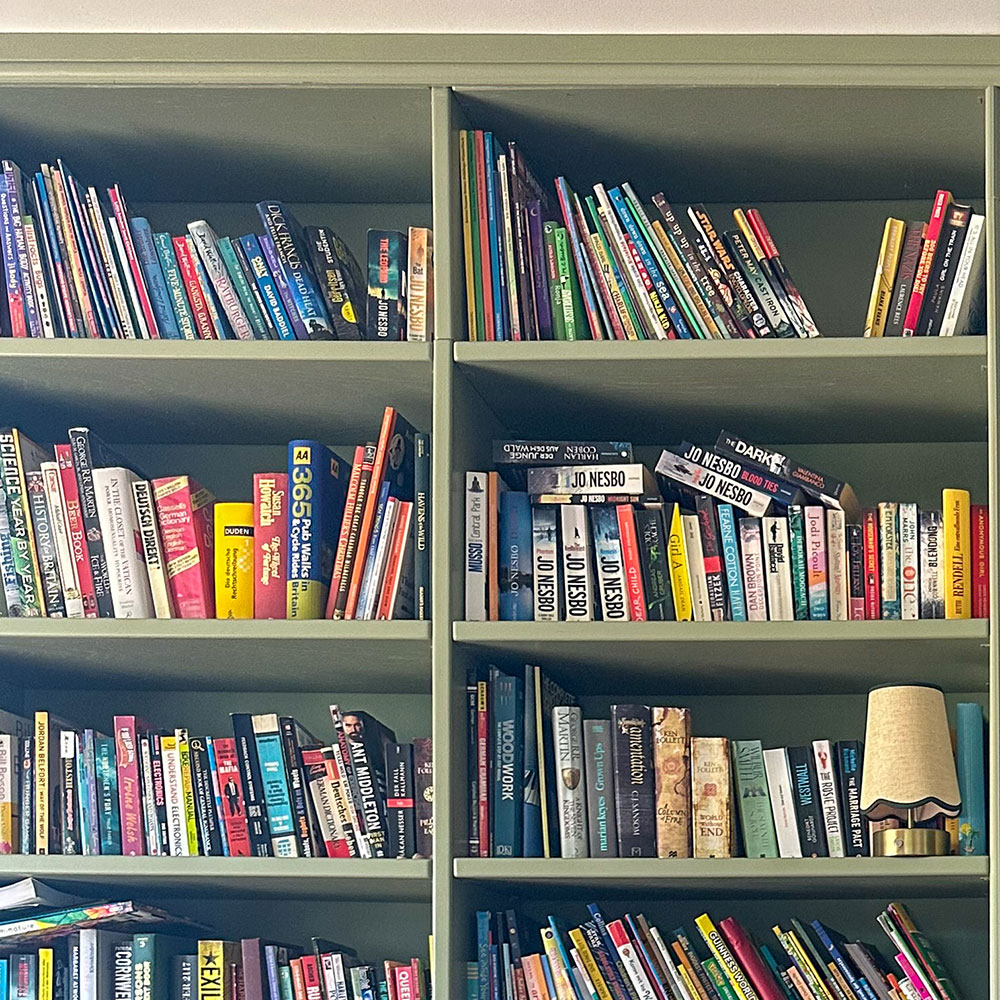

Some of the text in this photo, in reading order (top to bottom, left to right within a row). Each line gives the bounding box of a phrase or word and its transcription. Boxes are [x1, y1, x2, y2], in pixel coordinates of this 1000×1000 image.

[267, 204, 300, 270] DICK FRANCIS
[665, 209, 716, 298] up up up tree
[695, 210, 734, 271] STAR WARS
[15, 228, 32, 295] HUMAN BODY ACTIVITY
[731, 233, 780, 318] PETER MAY CAST IRON
[216, 277, 250, 340] RATBURGER
[264, 285, 289, 338] DAVID BADDIEL
[293, 271, 315, 318] DEAD HEAT
[410, 296, 425, 331] NESBO
[652, 279, 671, 302] sea
[732, 271, 759, 313] CHARACTER
[377, 312, 387, 337] NESBO
[659, 314, 670, 330] KID
[76, 437, 97, 518] GEORGE MARTIN
[295, 450, 308, 460] AA
[684, 446, 742, 479] JO NESBO
[259, 480, 275, 527] Howatch
[272, 491, 284, 516] Susan
[292, 469, 312, 517] 365
[572, 471, 625, 488] JO NESBO
[698, 473, 753, 506] JO NESBO
[741, 471, 779, 493] BLOOD TIES
[1, 434, 35, 604] SCIENCE YEAR BY YEAR
[67, 500, 84, 562] BEER BOOK
[110, 479, 133, 595] IN THE CLOSET VATICAN
[135, 483, 160, 566] DEUTSCH DIREKT
[333, 464, 362, 579] MALCOLM CHRISTMAS
[471, 497, 481, 538] Central Park
[33, 494, 59, 603] HISTORY BRITAIN
[301, 519, 312, 591] Pub Walks in
[468, 543, 483, 573] MUSSO
[670, 535, 683, 569] Girl A
[720, 508, 739, 586] FEARNE COTTON
[808, 514, 822, 578] Jodi Picoult
[291, 528, 300, 617] Cycle Rides Britain
[510, 545, 519, 597] JO NESBO
[537, 556, 555, 613] JO NESBO
[566, 553, 588, 617] JO NESBO
[601, 556, 624, 619] JO NESBO
[712, 574, 724, 606] FITZEK
[748, 554, 758, 610] DAN BROWN
[952, 553, 963, 597] RENDELL
[502, 720, 514, 801] WOODWORK
[558, 712, 570, 762] MARTIN
[38, 754, 46, 787] BELFORT
[153, 760, 164, 806] ELECTRONICS
[350, 742, 380, 830] ANT MIDDLETON
[595, 743, 606, 791] Grown Ups
[697, 766, 724, 774] FOLLETT
[800, 762, 811, 806] WESTWALL
[124, 777, 138, 843] Irvine Welsh
[167, 753, 183, 856] UNDERSTAND ELECTRONICS
[186, 791, 195, 822] MANUAL
[331, 781, 346, 825] Deutsches
[700, 814, 723, 822] WORLD
[822, 782, 839, 833] ROSIE PROJECT
[848, 788, 862, 848] MARRIAGE PACT
[700, 828, 723, 837] END
[593, 912, 606, 936] Collins
[182, 962, 191, 984] 2117
[709, 932, 740, 975] GUINNESS
